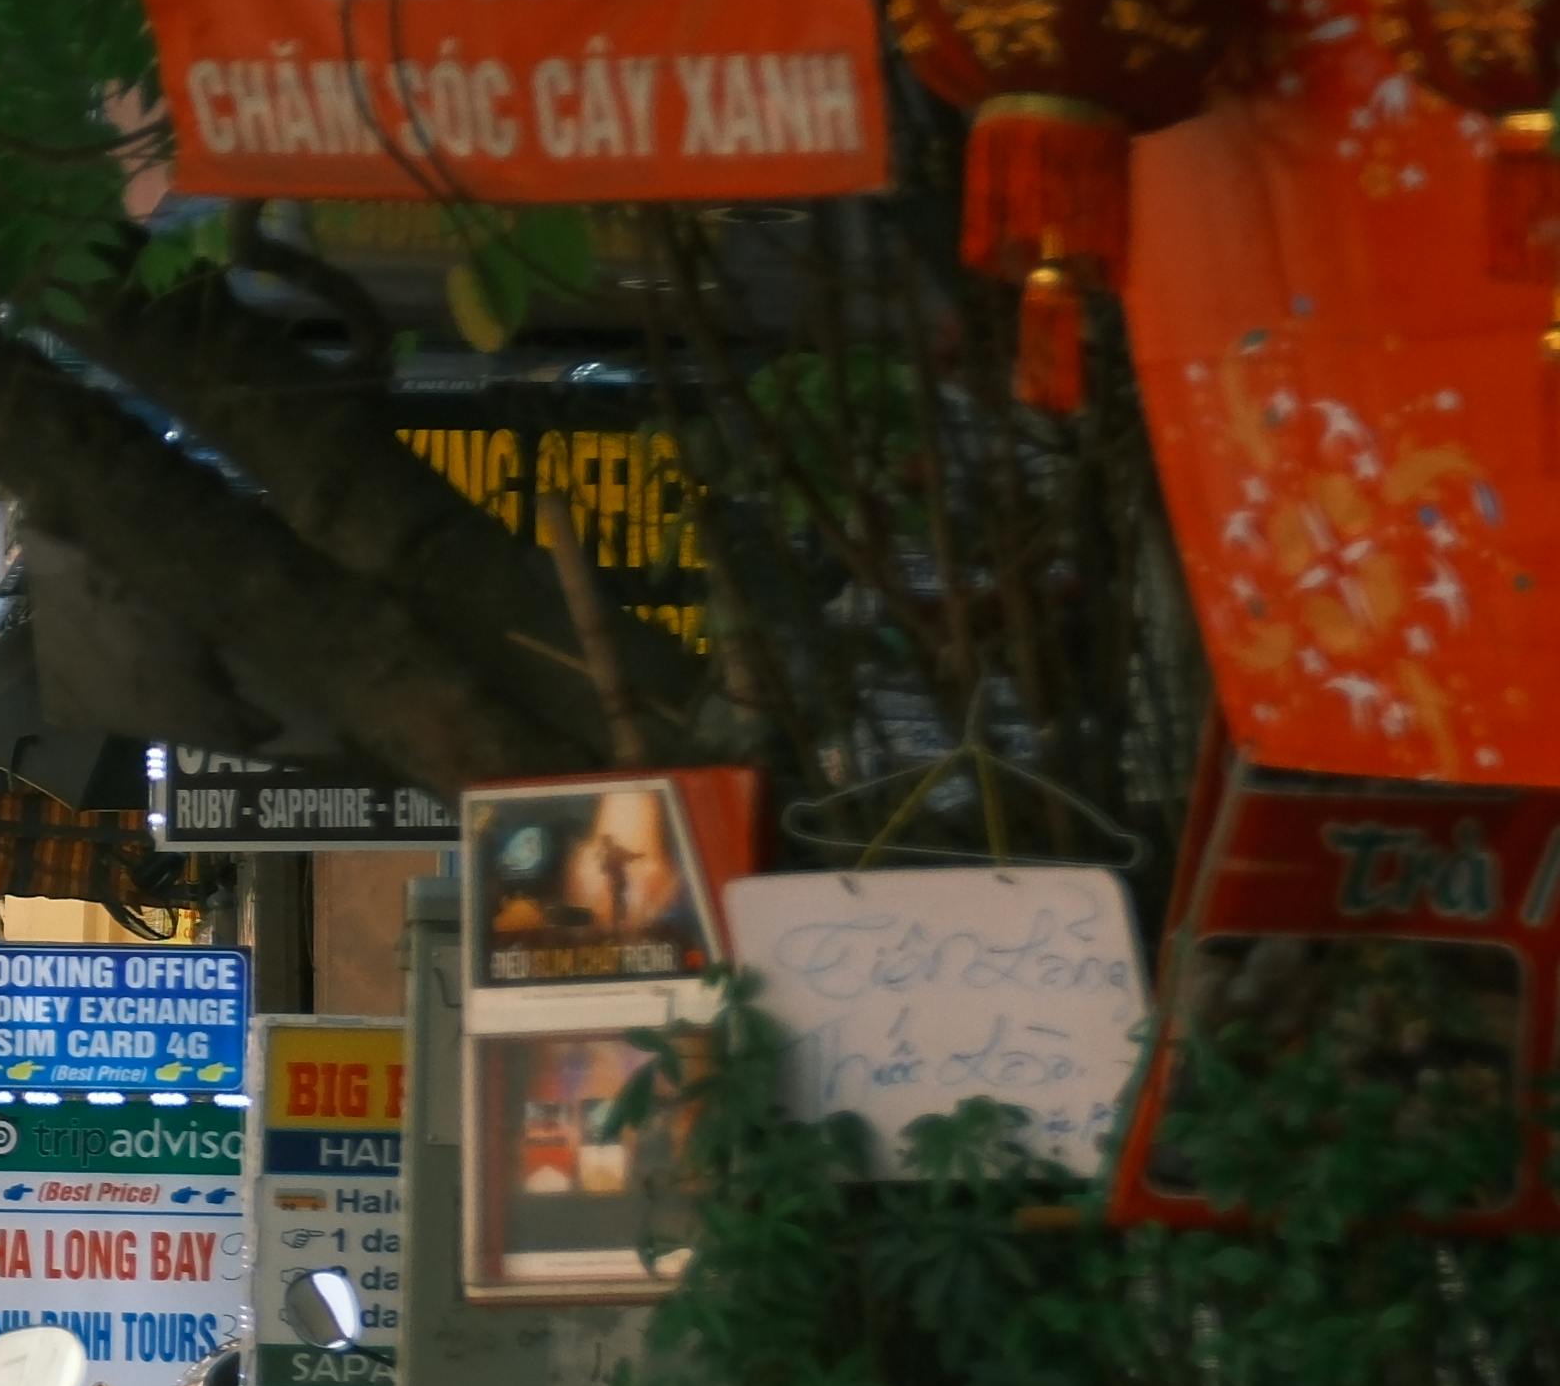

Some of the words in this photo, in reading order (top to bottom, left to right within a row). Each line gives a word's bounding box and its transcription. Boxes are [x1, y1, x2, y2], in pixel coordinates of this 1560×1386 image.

[397, 35, 520, 160] SÓC
[531, 33, 664, 161] CÂY
[678, 50, 866, 157] XANH
[176, 789, 236, 830] RUBY
[258, 788, 371, 830] SAPPHIRE
[124, 957, 237, 991] OFFICE
[78, 996, 237, 1026] EXCHANGE
[67, 1029, 157, 1059] CARD
[166, 1030, 210, 1059] 4G
[50, 1065, 95, 1083] (Best
[96, 1065, 148, 1084] Price)
[286, 1062, 369, 1119] BIG
[37, 1181, 93, 1203] (Best
[96, 1182, 161, 1205] Price)
[335, 1187, 401, 1214] Hal
[44, 1229, 137, 1281] LONG
[150, 1231, 217, 1282] BAY
[332, 1228, 346, 1253] 1
[122, 1312, 217, 1363] TOURS
